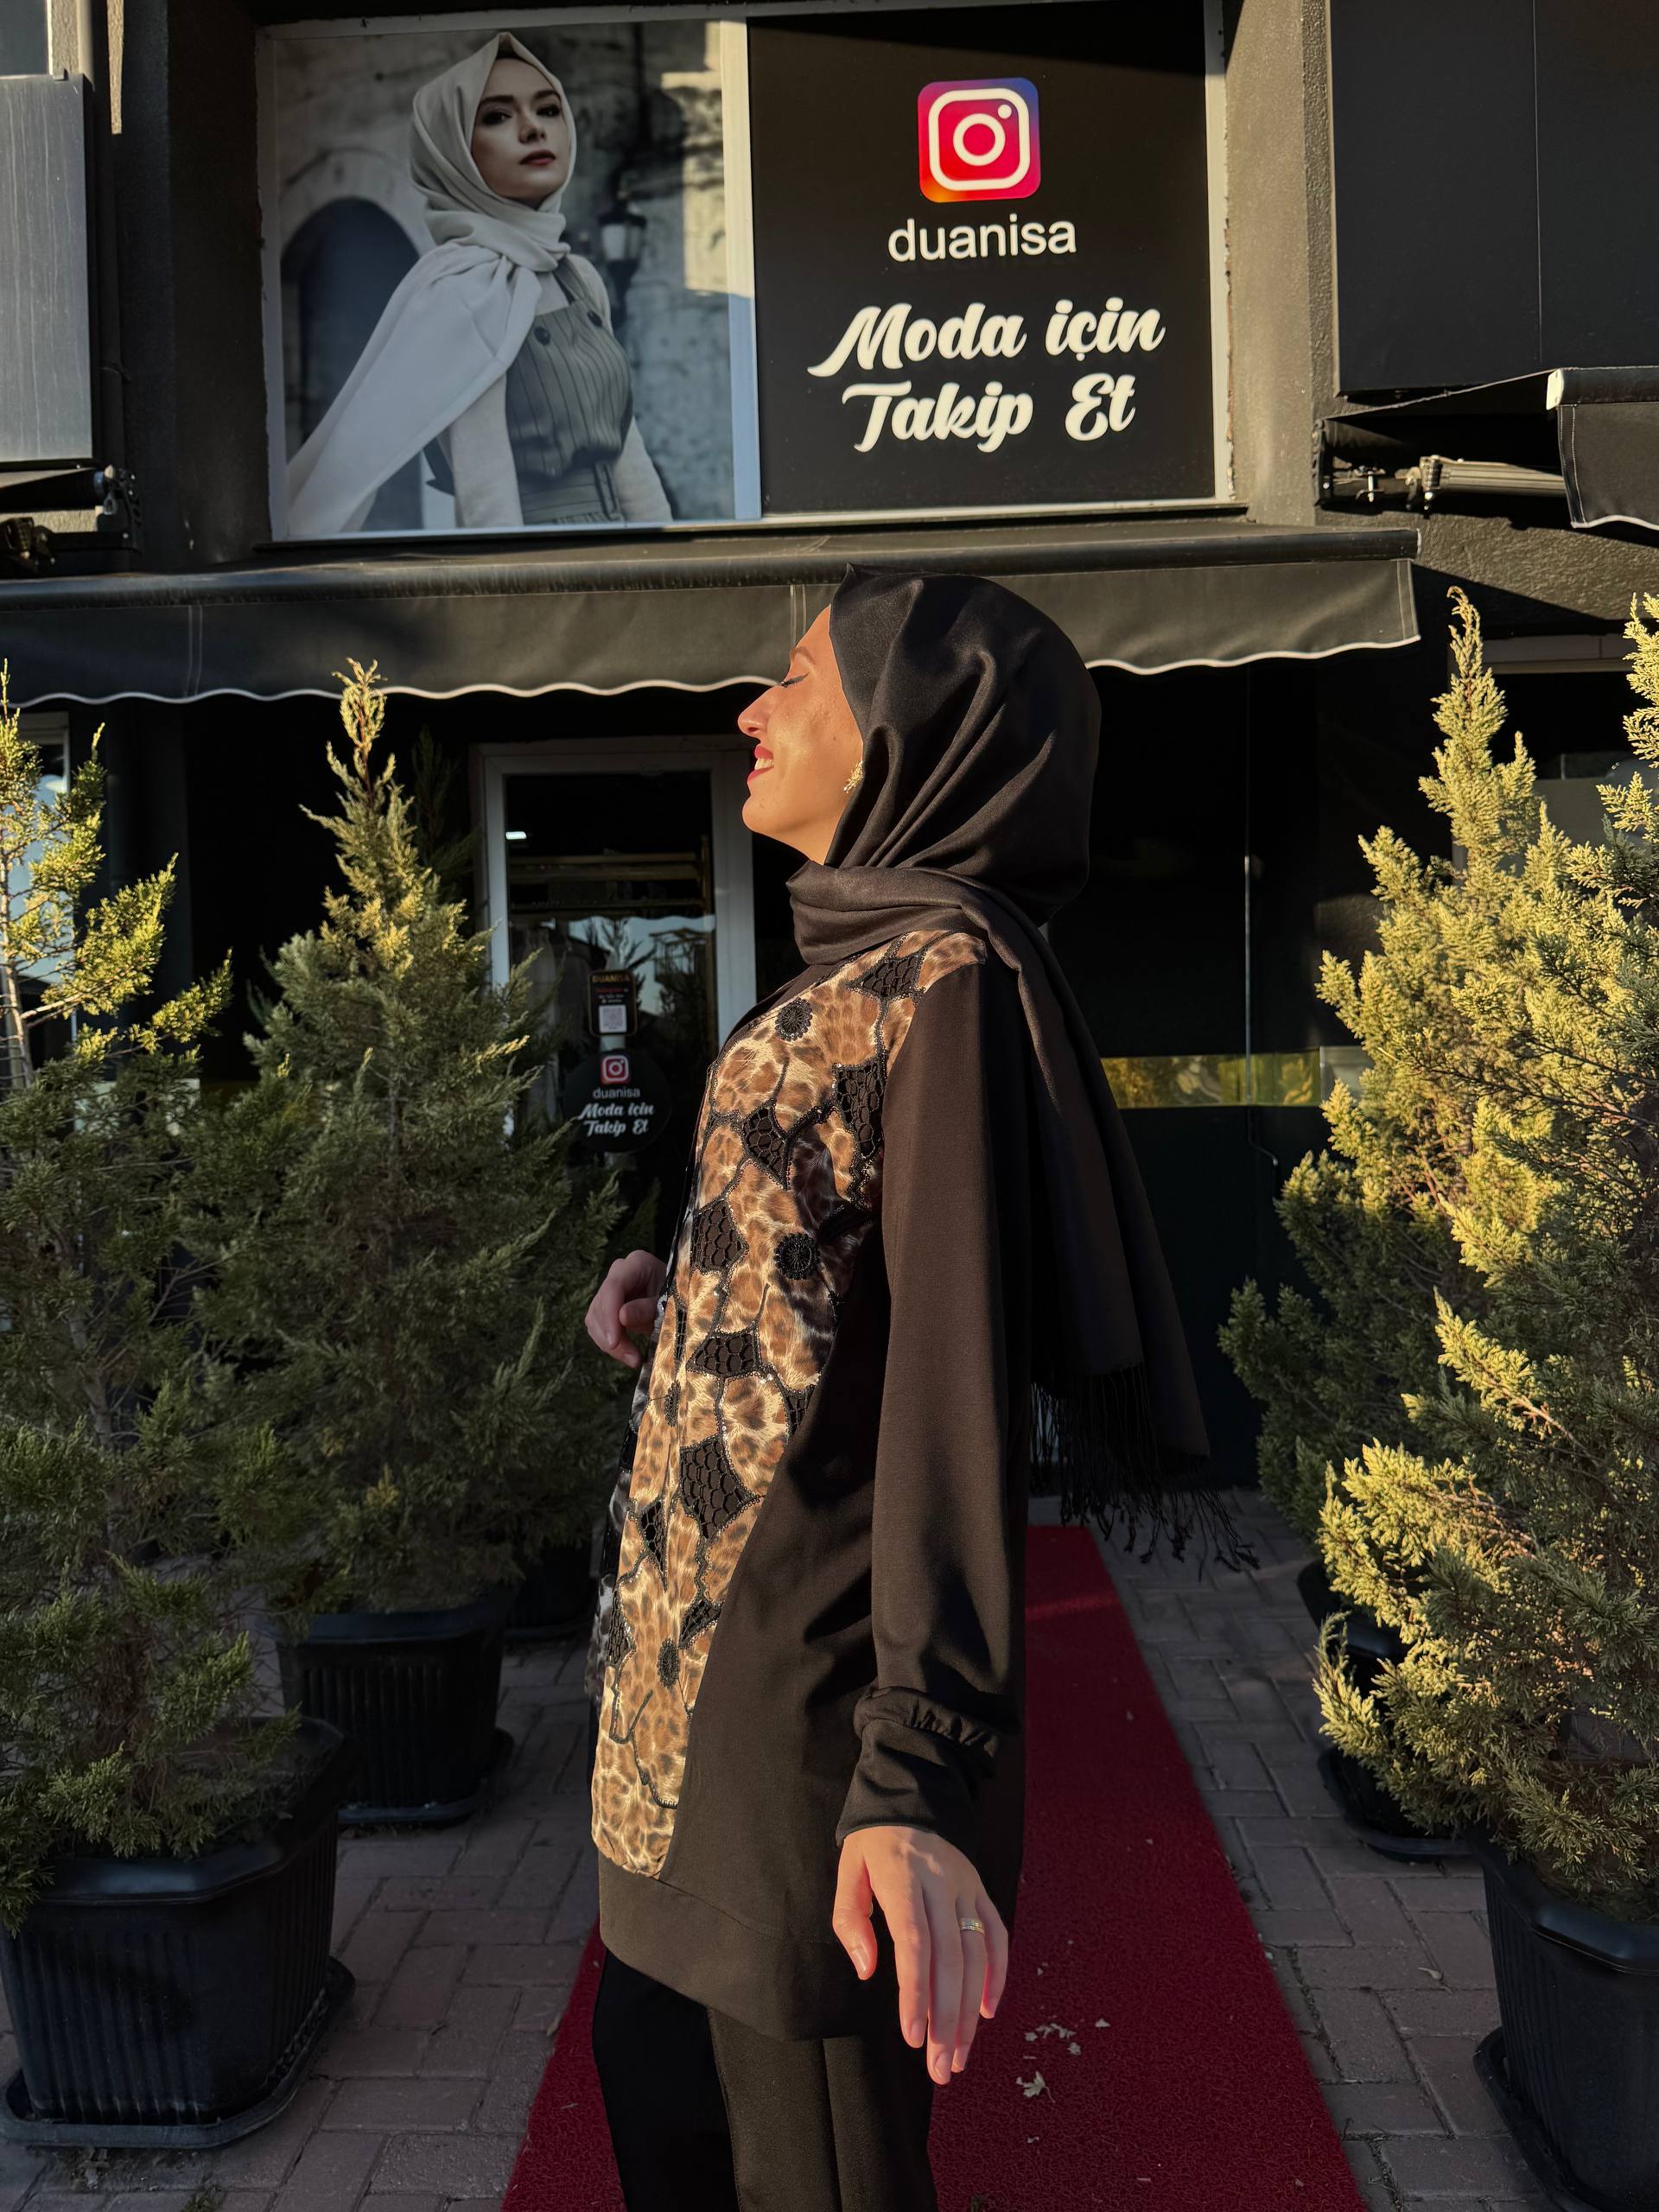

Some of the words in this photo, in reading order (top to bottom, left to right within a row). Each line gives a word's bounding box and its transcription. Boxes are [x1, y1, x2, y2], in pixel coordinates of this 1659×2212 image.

[888, 213, 1077, 262] duanisa
[807, 302, 1027, 378] Moda
[1045, 296, 1166, 361] için
[842, 380, 1033, 454] Takip
[1065, 372, 1136, 442] Et
[592, 1087, 641, 1100] duanisa
[579, 1103, 626, 1120] Moda
[627, 1102, 655, 1116] için
[583, 1120, 626, 1137] Takip
[632, 1118, 649, 1135] Et
